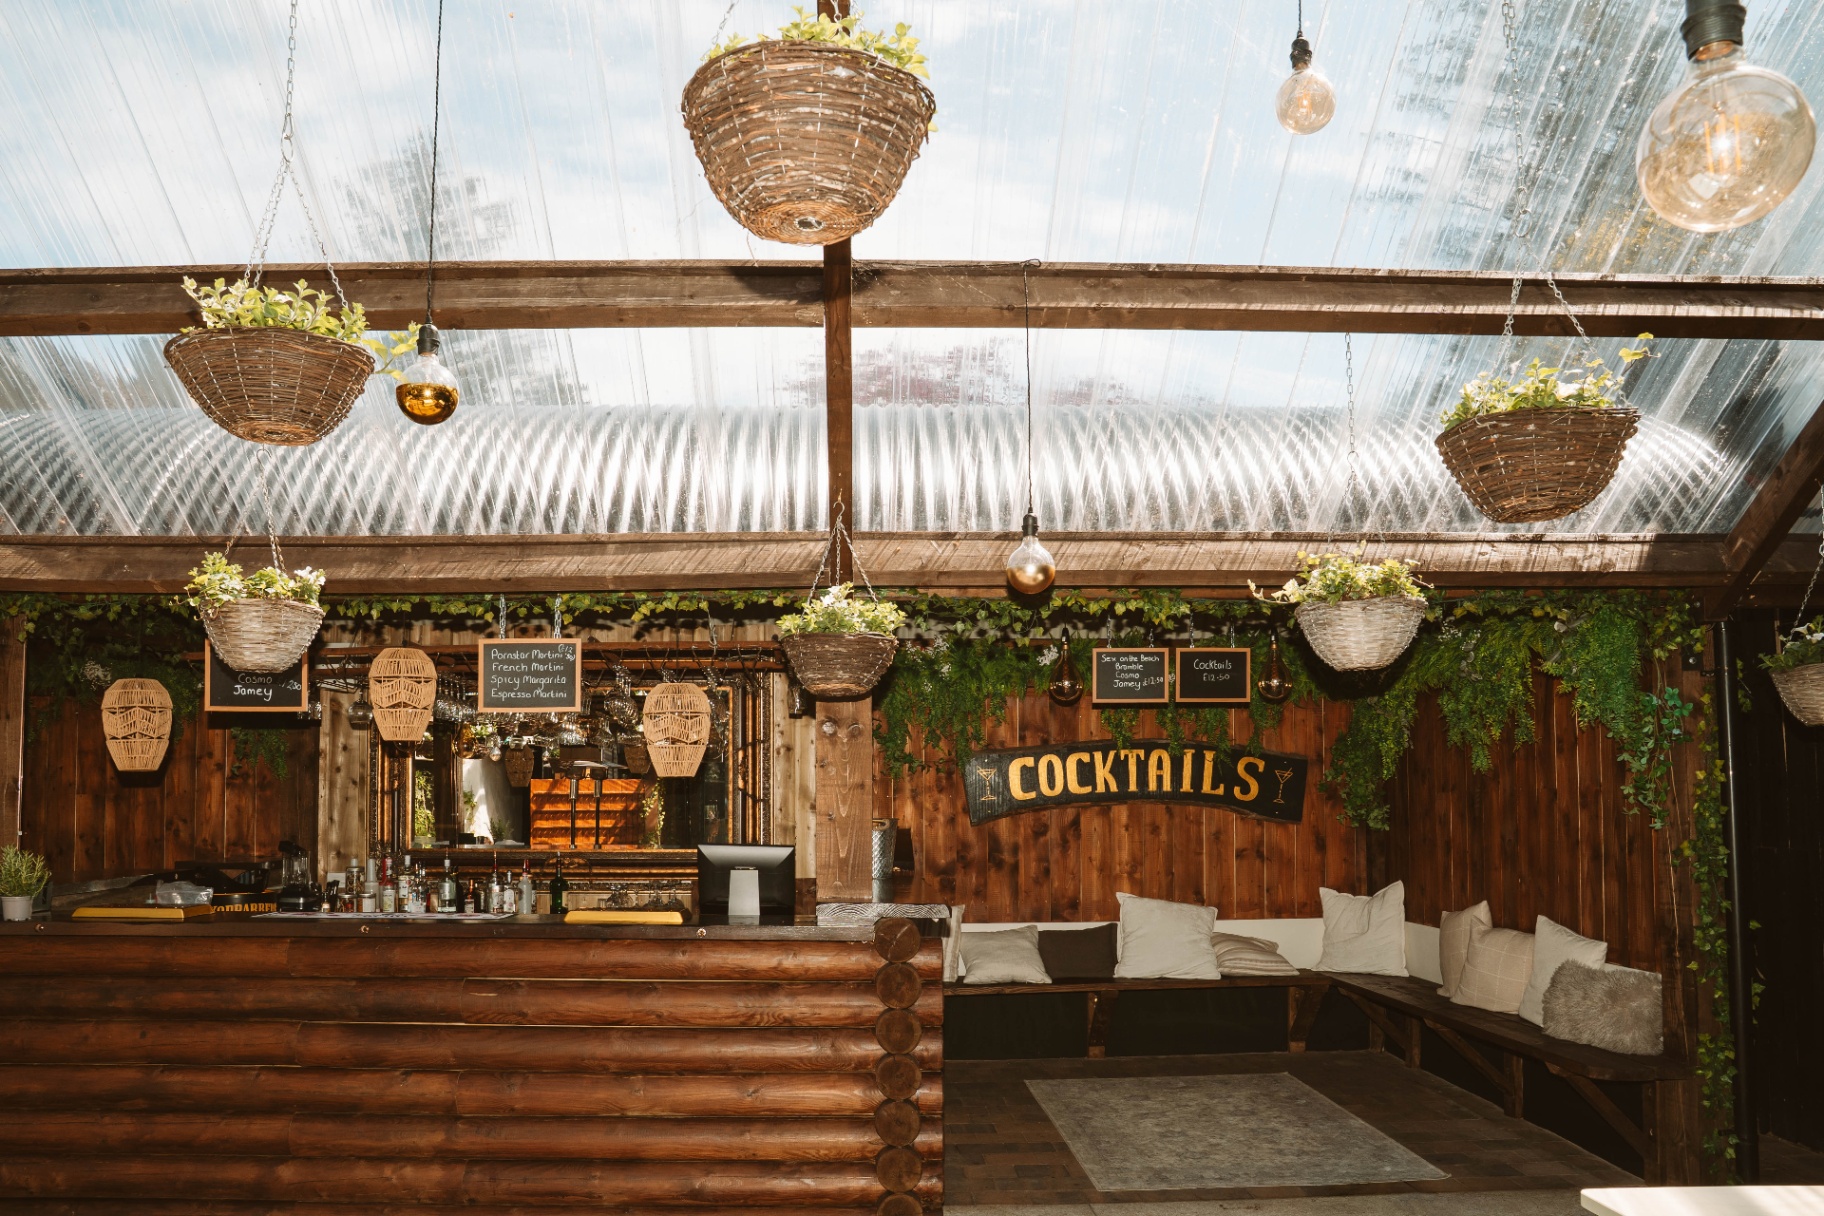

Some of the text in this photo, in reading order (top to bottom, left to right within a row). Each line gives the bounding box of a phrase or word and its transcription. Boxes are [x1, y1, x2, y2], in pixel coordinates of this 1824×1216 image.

[491, 649, 563, 659] Pornstar Martini
[1101, 654, 1117, 662] Sex
[1140, 654, 1160, 662] Beach
[492, 662, 564, 672] French Martini
[1115, 662, 1144, 670] Bramble
[1193, 658, 1232, 670] Cocktails
[237, 673, 273, 684] Cosmo
[1115, 671, 1140, 679] Cosmo
[490, 675, 566, 690] Spicy Margarita
[1113, 679, 1141, 691] Jamey
[233, 684, 273, 701] Jamey
[491, 687, 567, 701] Espresso Martini
[1008, 748, 1265, 801] COCKTAILS
